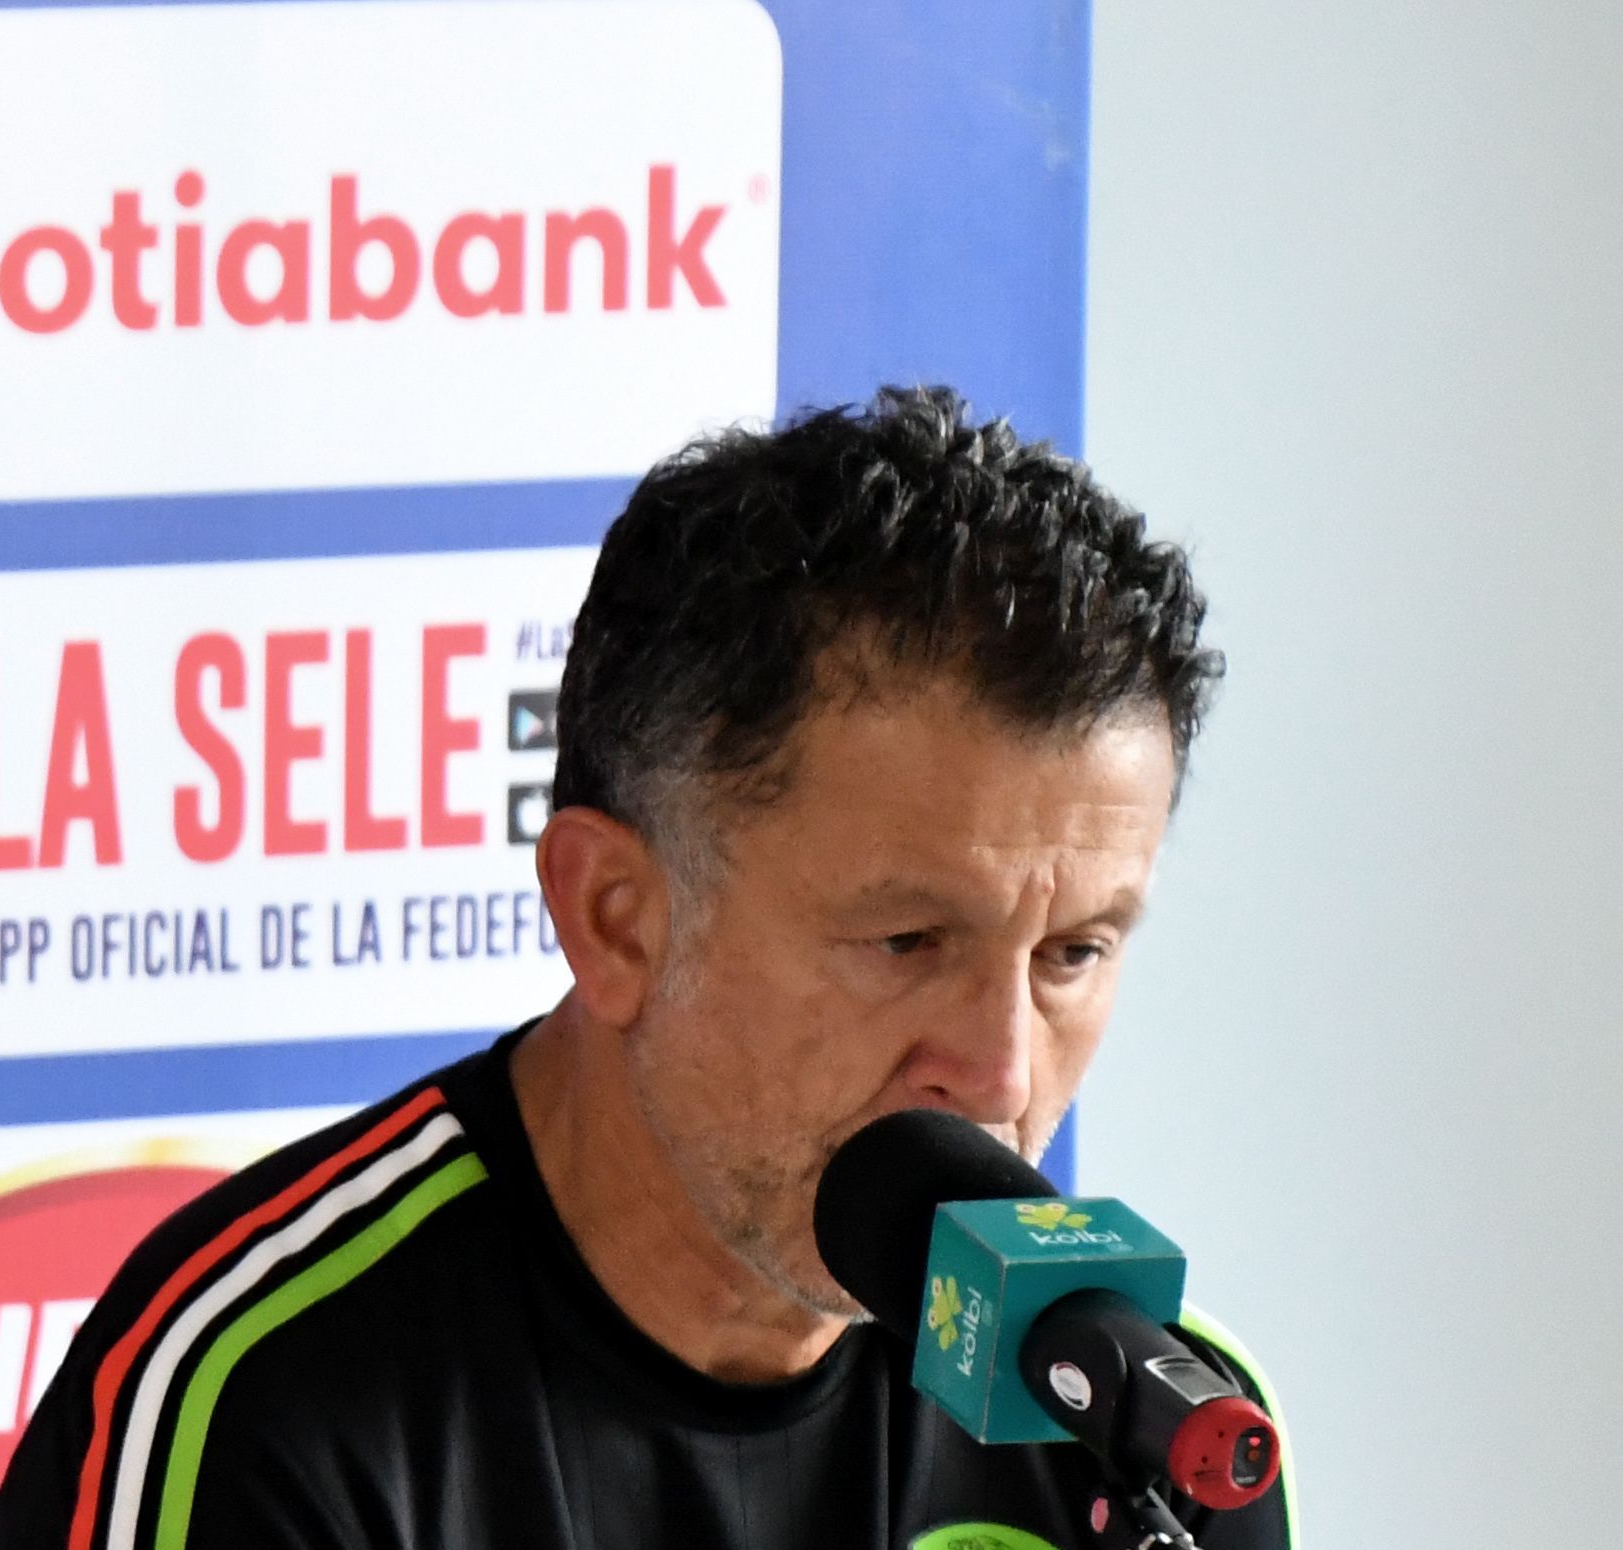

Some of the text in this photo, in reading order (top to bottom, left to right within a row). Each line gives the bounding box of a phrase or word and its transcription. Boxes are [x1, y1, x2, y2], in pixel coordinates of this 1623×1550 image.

[172, 622, 488, 865] SELE
[68, 908, 242, 981] OFICIAL
[259, 903, 312, 971] DE
[331, 898, 383, 968] LA
